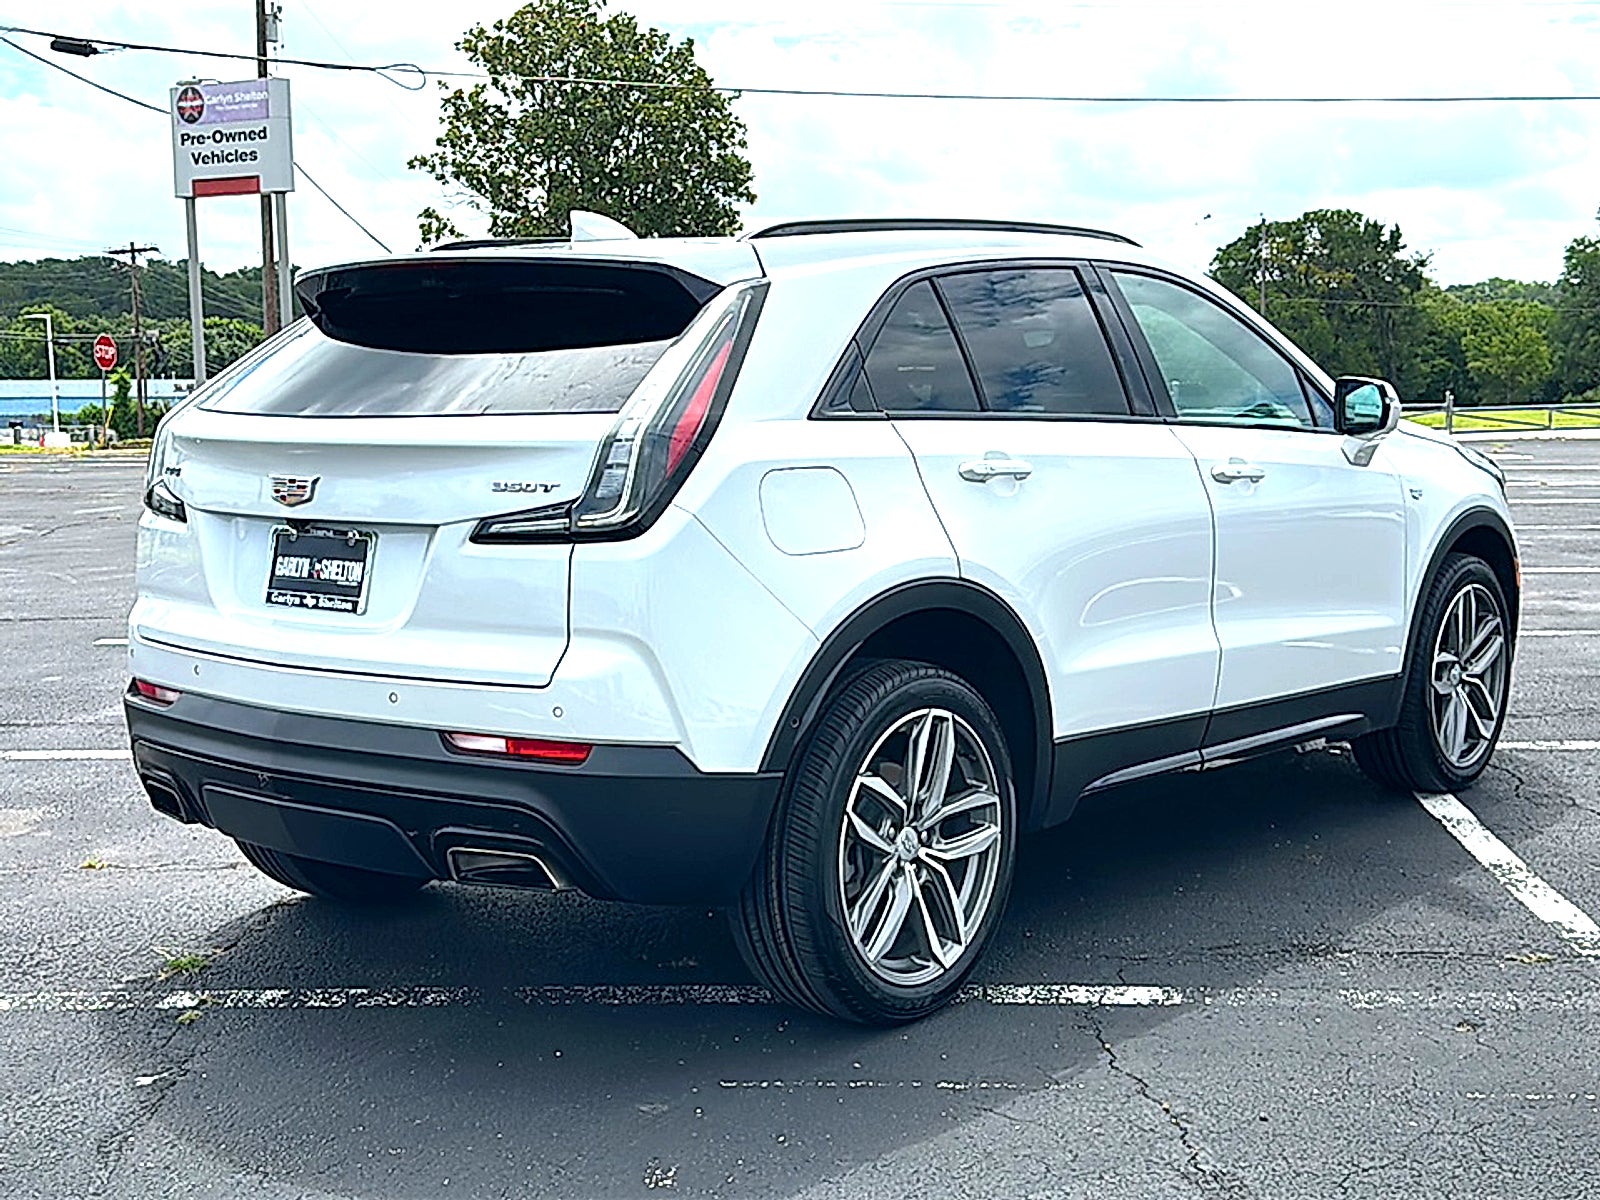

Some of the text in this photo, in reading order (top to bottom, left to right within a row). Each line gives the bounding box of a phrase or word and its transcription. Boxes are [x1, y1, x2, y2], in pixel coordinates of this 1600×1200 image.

[180, 126, 268, 146] Pre-Owned
[191, 148, 258, 165] Vehicles
[95, 344, 115, 359] STOP
[320, 559, 365, 583] SHELTON
